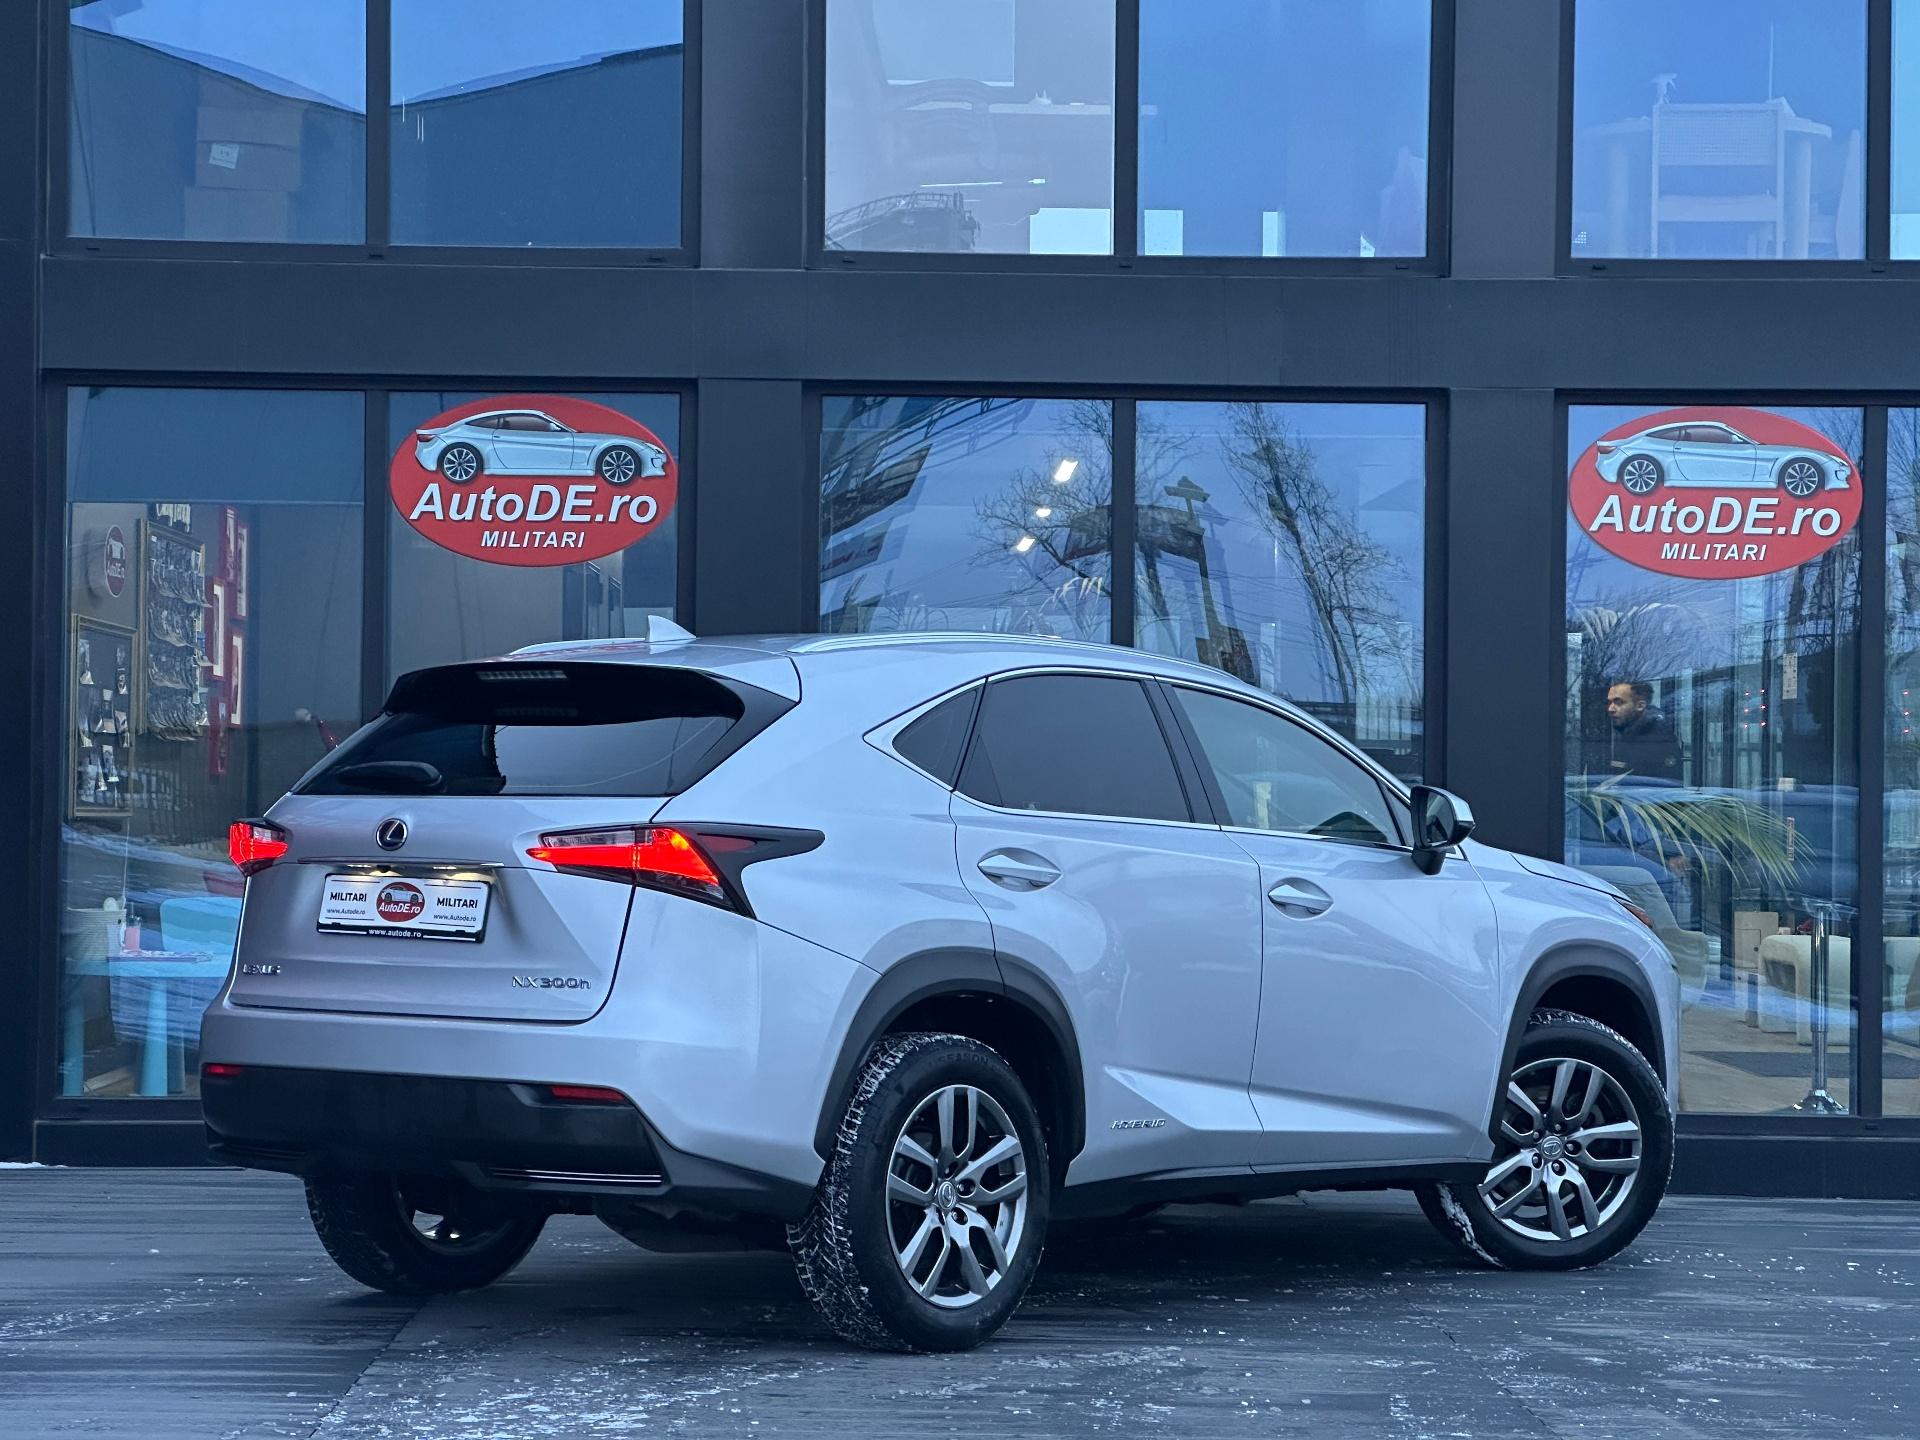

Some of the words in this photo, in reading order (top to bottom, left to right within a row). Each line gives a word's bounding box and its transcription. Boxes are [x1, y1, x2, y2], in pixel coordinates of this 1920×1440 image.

[409, 482, 657, 523] AutoDE.ro
[1589, 494, 1842, 537] AutoDE.ro
[480, 531, 585, 548] MILITARI
[1660, 543, 1767, 561] MILITARI
[329, 891, 367, 902] MILITARI
[378, 902, 421, 914] AutoDE.ro
[436, 897, 478, 909] MILITARI
[433, 913, 477, 922] www.Autode.ro
[368, 928, 422, 938] www.autode.ro
[1110, 1118, 1167, 1129] HYBRID
